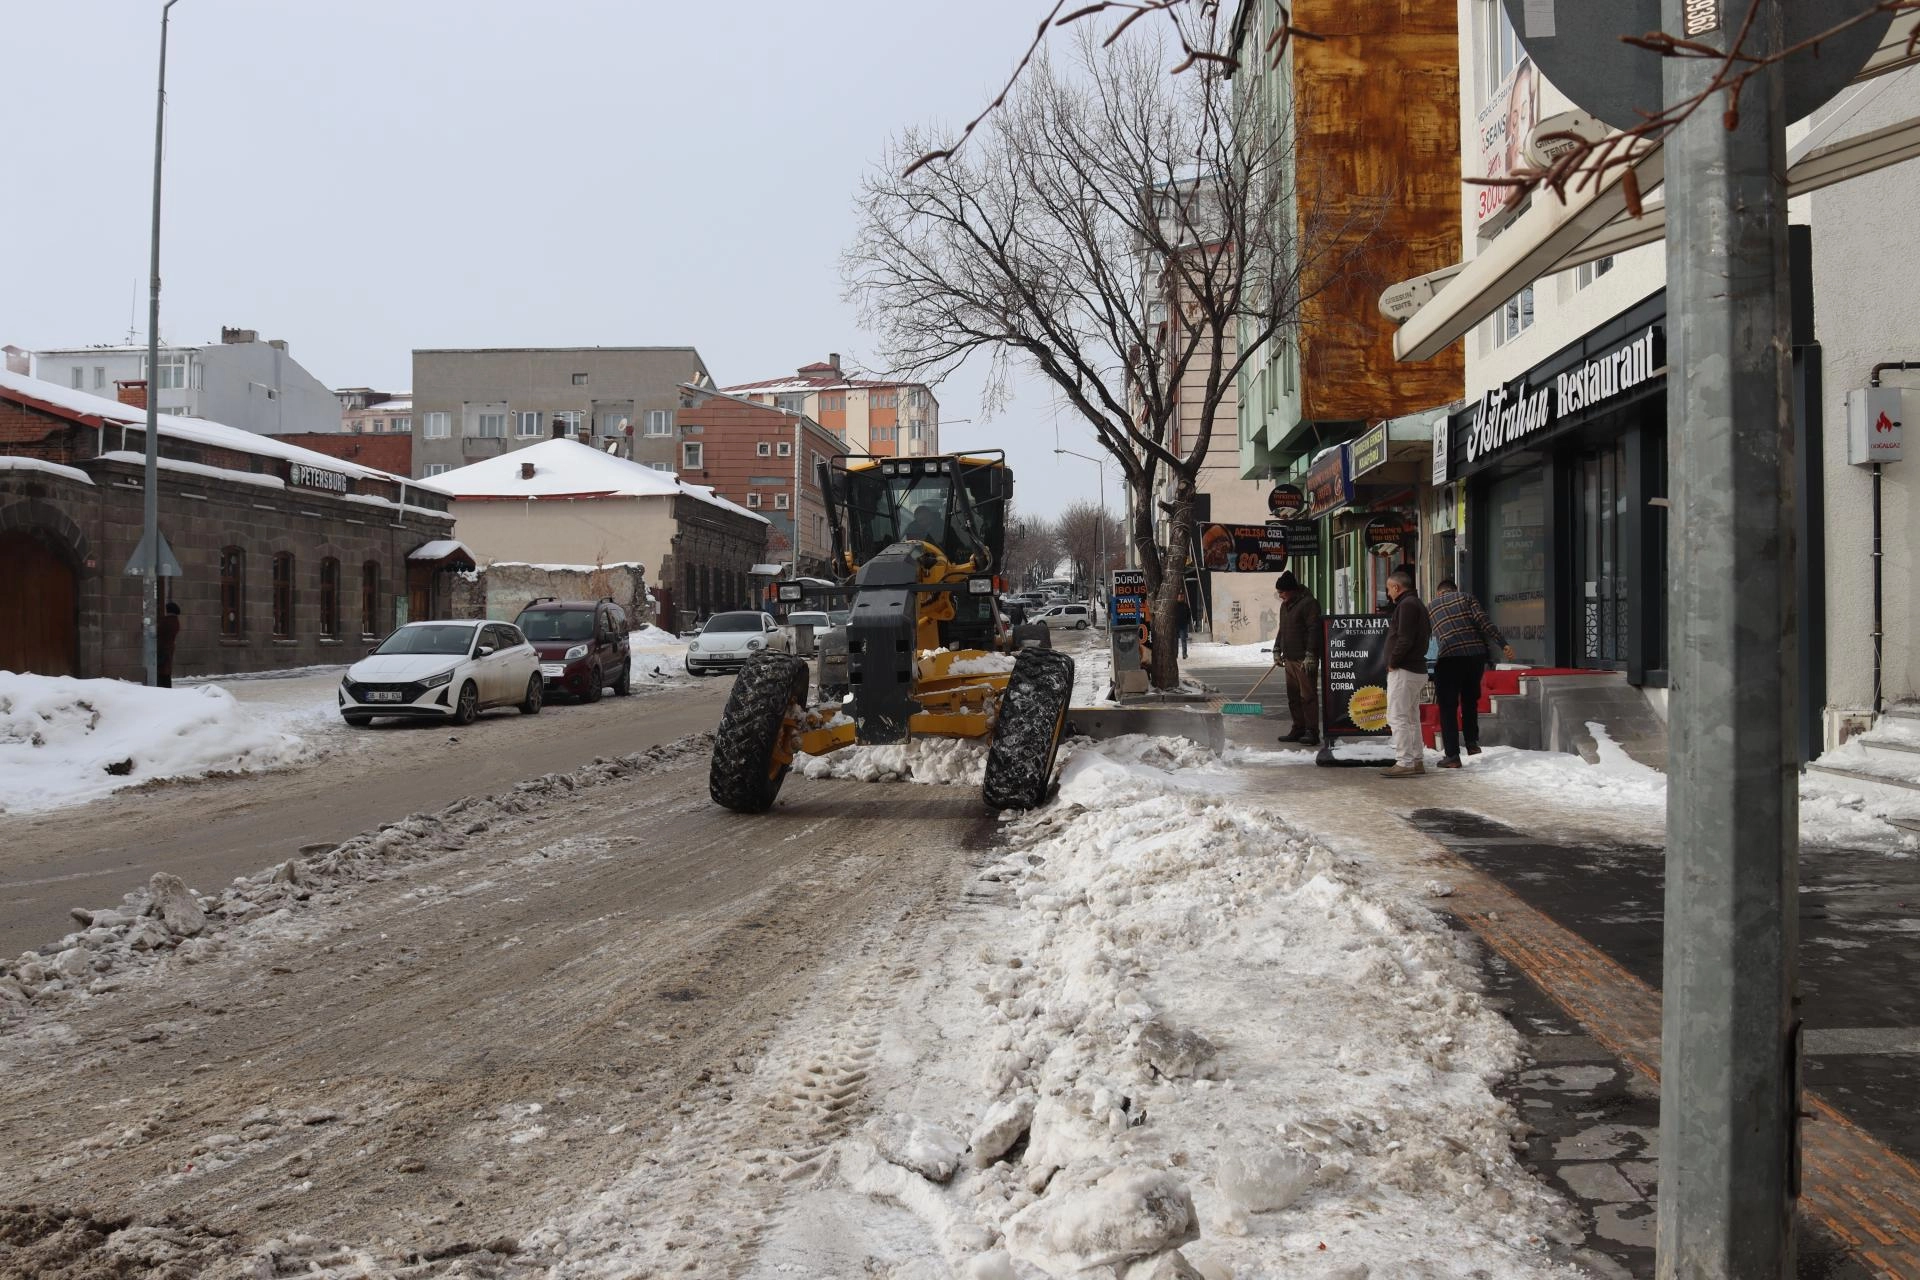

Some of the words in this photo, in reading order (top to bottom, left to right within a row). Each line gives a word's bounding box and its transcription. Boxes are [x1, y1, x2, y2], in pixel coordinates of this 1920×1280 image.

[1486, 113, 1506, 150] SEANS
[1543, 141, 1576, 160] TENTE
[1466, 381, 1550, 463] Astrahan
[1556, 325, 1654, 419] Restaurant
[300, 466, 347, 493] PETERSBURG
[1267, 528, 1284, 539] ÖZEL
[1133, 586, 1147, 594] US
[1332, 618, 1390, 629] ASTRAHA
[1330, 638, 1346, 648] PİDE
[1330, 650, 1369, 658] LAHMACUN
[1330, 661, 1354, 669] KEBAP
[1330, 672, 1356, 680] IZGARA
[1330, 682, 1355, 692] ÇORBA
